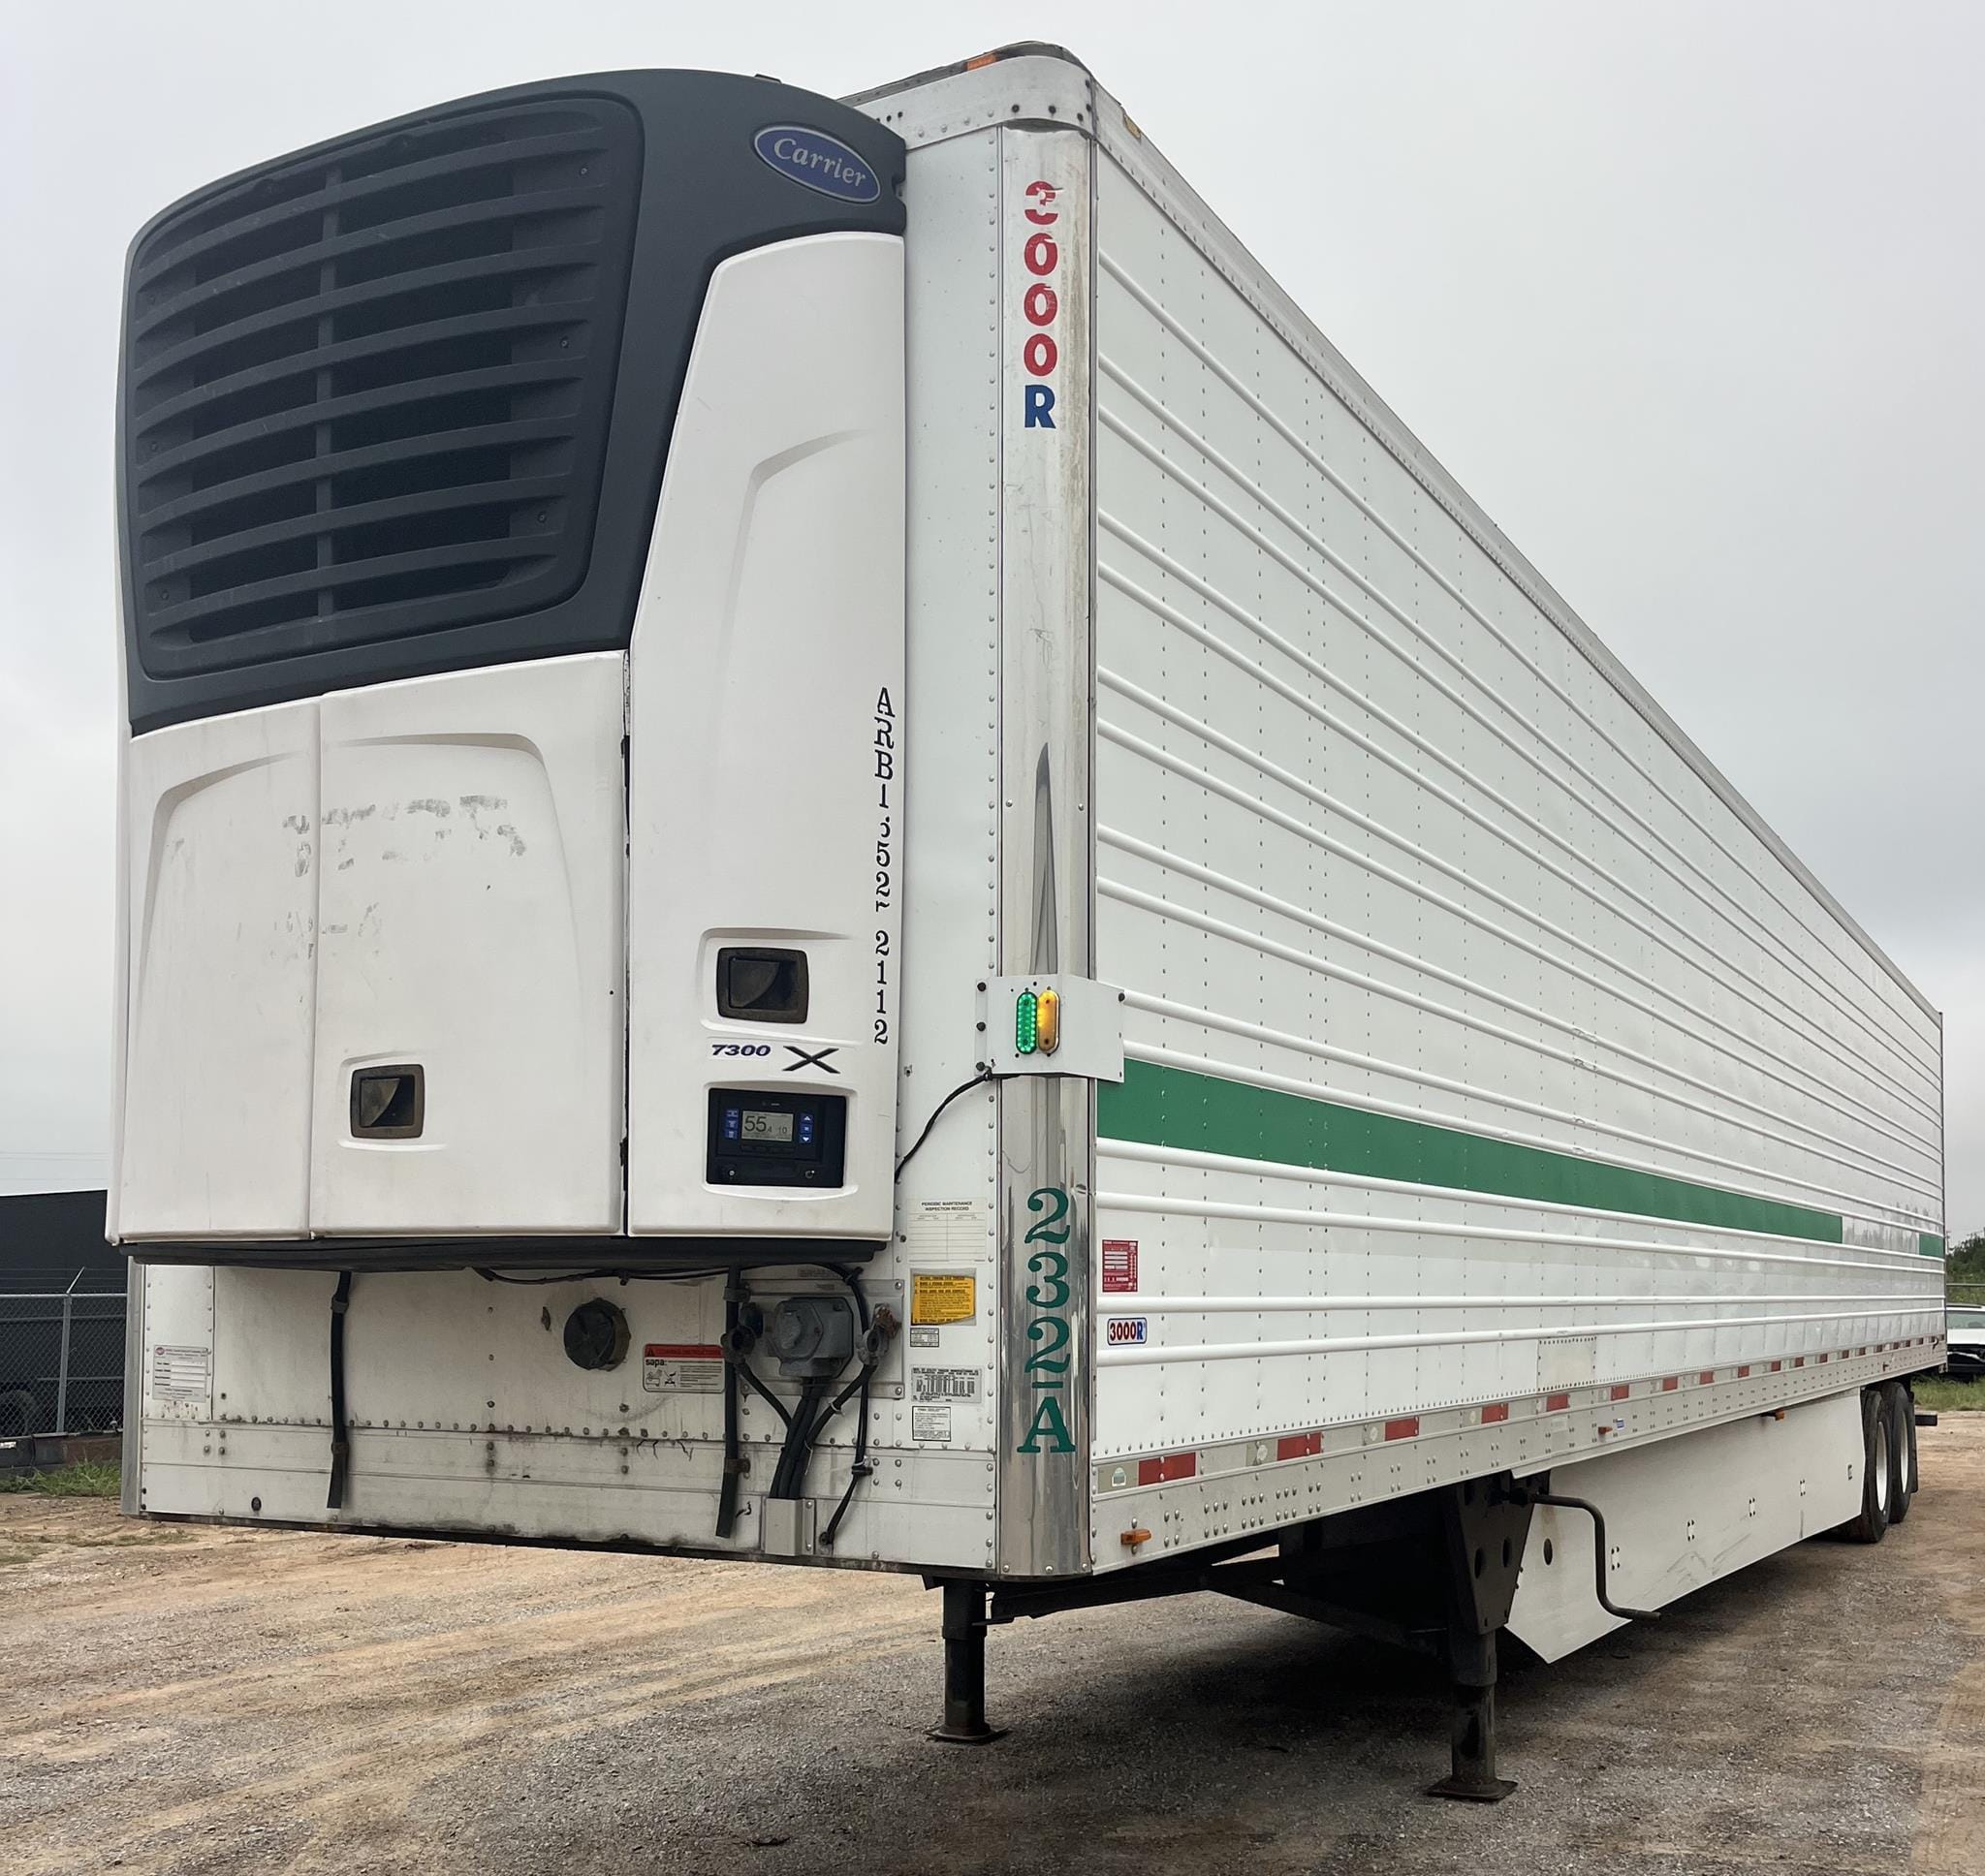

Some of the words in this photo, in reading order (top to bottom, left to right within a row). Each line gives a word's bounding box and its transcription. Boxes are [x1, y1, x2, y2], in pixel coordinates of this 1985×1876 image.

[773, 138, 866, 187] Carrier
[1024, 180, 1059, 428] 3000R
[711, 1044, 772, 1057] 7300
[1016, 1187, 1076, 1454] 232-A
[1110, 1322, 1144, 1342] 3000R
